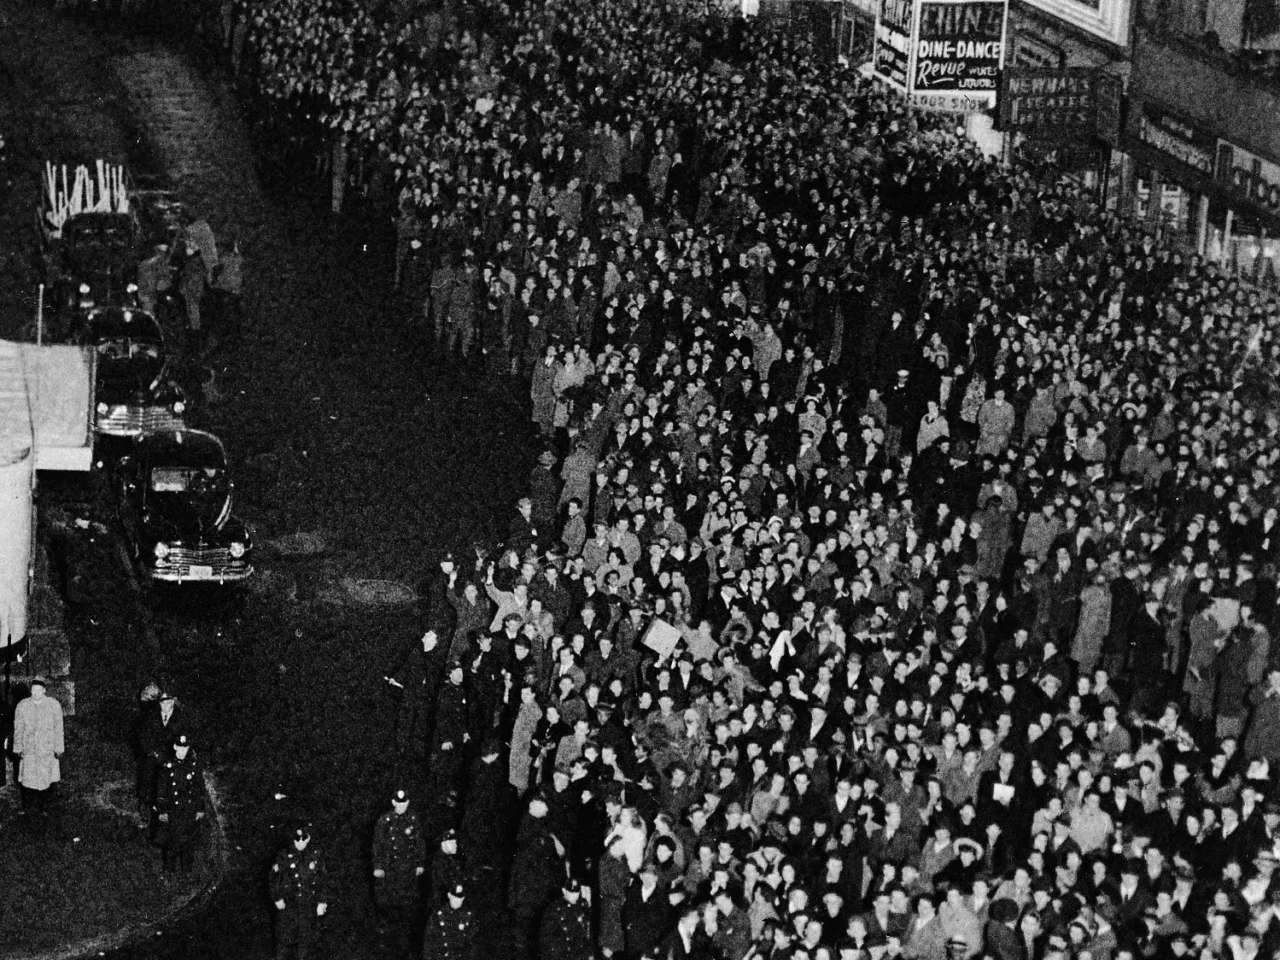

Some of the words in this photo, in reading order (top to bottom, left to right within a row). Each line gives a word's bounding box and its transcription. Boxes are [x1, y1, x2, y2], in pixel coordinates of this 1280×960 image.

[919, 40, 1001, 59] DINE-DANCE
[917, 60, 966, 87] Revue
[959, 78, 997, 88] LIQUORS
